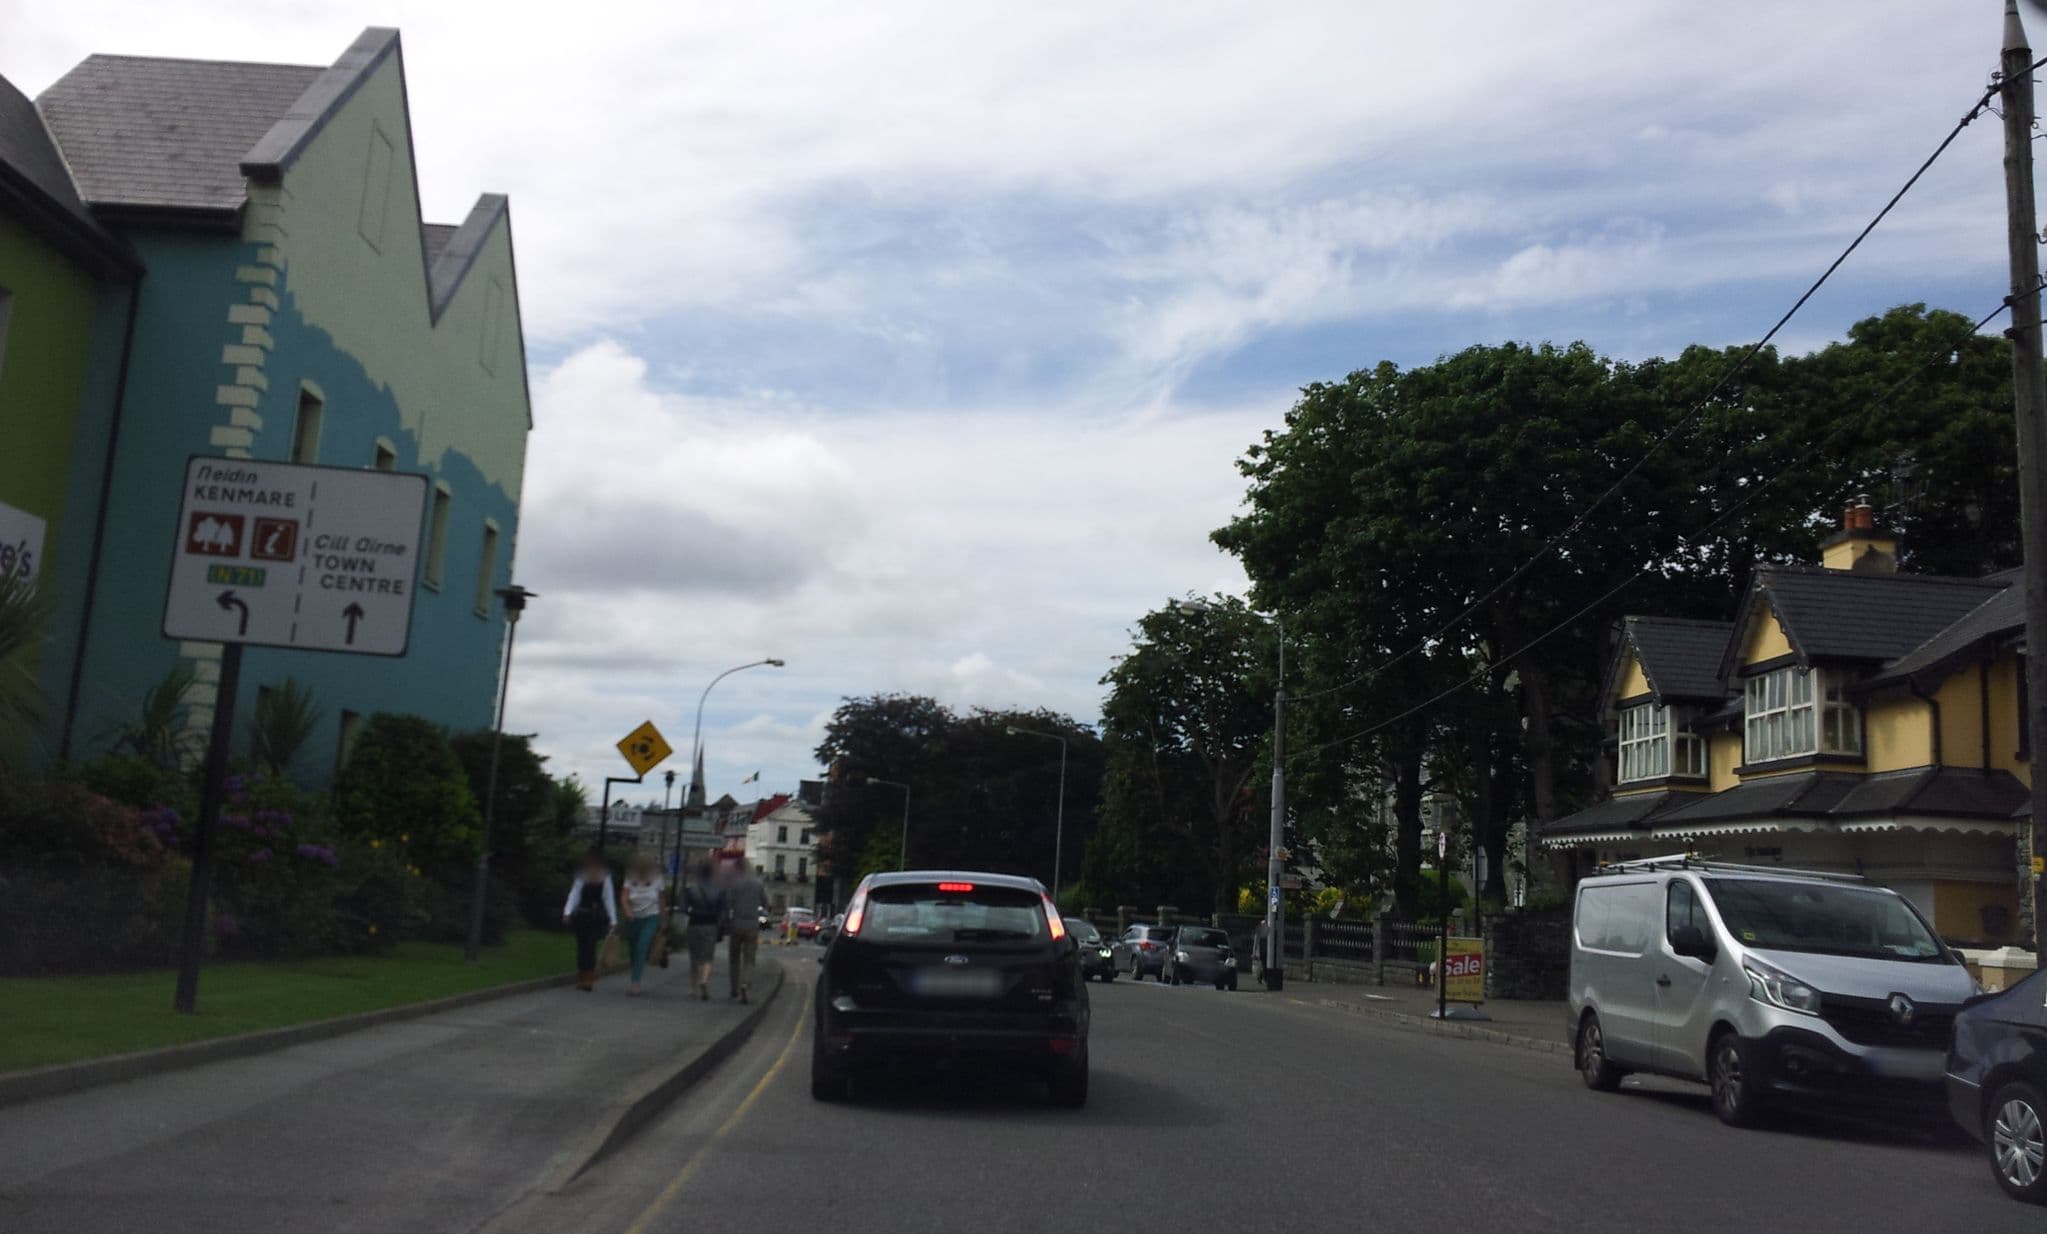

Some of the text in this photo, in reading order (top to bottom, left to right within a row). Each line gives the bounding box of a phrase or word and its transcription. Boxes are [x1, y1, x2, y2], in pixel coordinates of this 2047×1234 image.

[194, 484, 296, 508] KENMARE
[313, 553, 376, 572] TOWN
[319, 573, 405, 595] CENTRE
